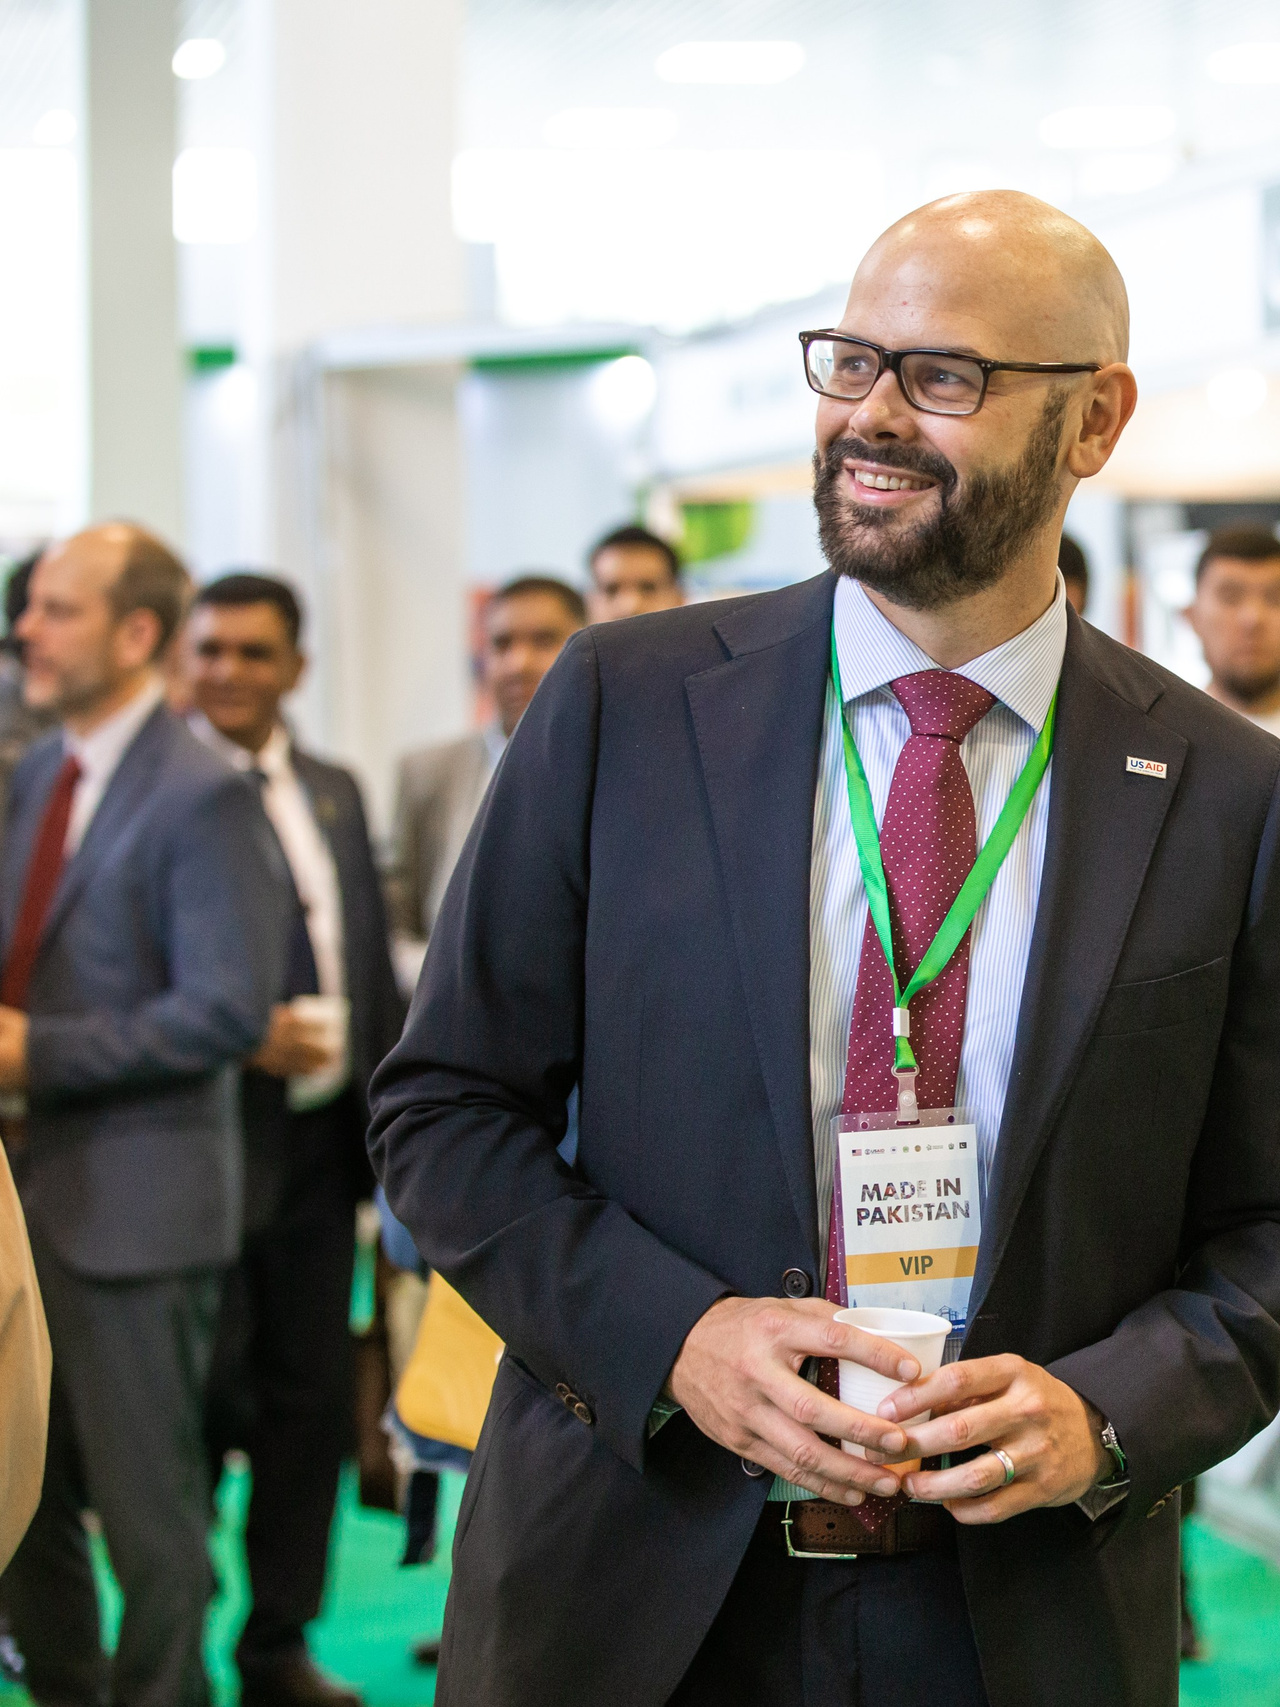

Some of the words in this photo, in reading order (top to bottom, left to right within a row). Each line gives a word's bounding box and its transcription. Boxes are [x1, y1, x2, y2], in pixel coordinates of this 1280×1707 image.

[1130, 759, 1164, 773] USAID
[860, 1180, 928, 1203] MADE
[935, 1177, 962, 1197] IN
[856, 1200, 970, 1226] PAKISTAN
[899, 1255, 934, 1276] VIP
